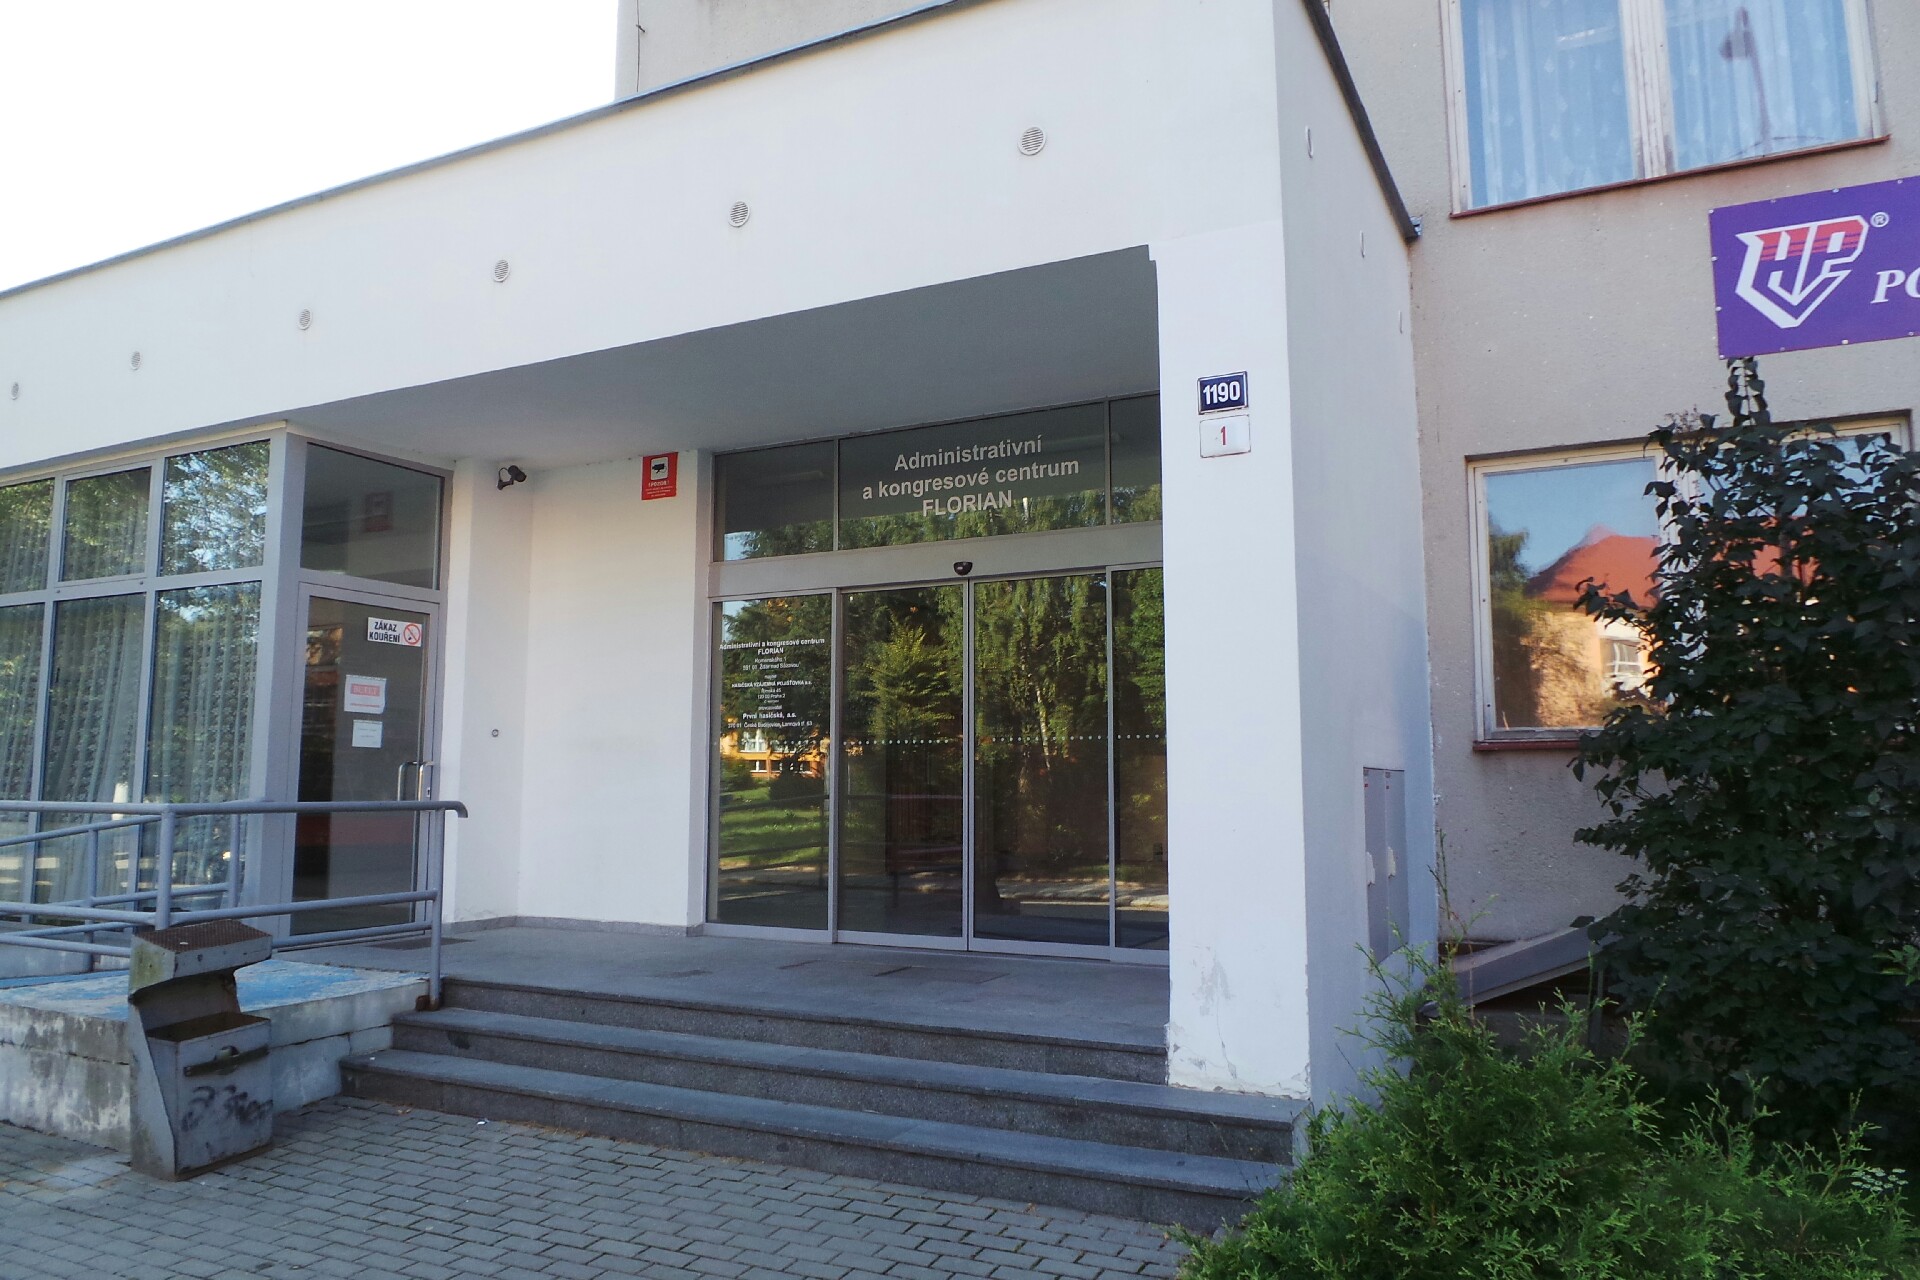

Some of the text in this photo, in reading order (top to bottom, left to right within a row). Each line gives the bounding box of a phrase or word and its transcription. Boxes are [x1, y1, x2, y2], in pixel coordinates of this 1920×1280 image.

[1203, 381, 1240, 405] 1190
[1220, 426, 1227, 446] 1
[894, 435, 1042, 471] Administrativní
[862, 460, 1079, 500] a kongresové centrum
[922, 490, 1012, 517] FLORIAN
[374, 620, 397, 632] ZÁKAZ
[369, 631, 401, 643] KOUŘENÍ
[719, 641, 761, 650] Administrativní
[766, 639, 800, 648] kongresové
[757, 647, 784, 655] FLORIAN
